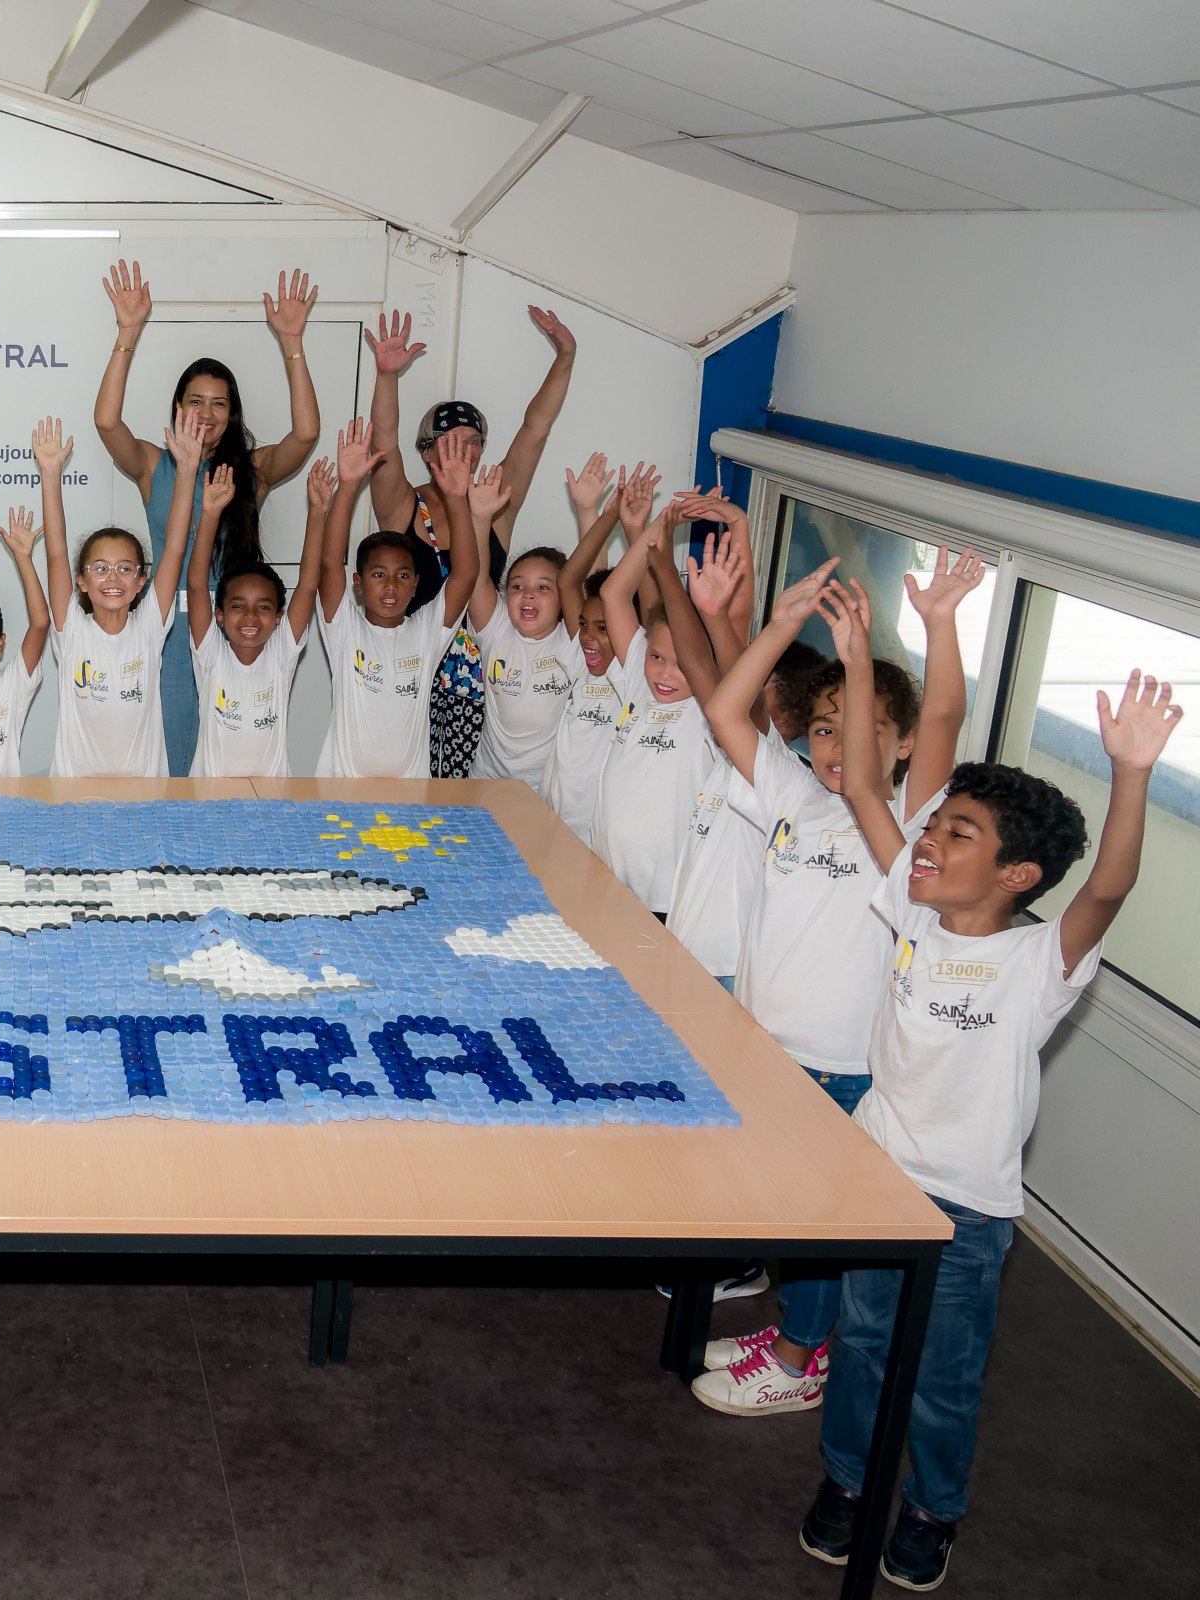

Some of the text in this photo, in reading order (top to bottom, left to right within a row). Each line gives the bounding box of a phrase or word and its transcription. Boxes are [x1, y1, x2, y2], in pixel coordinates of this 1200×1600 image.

[936, 963, 984, 978] 13000
[955, 1012, 997, 1029] PAUL
[756, 1381, 812, 1405] Sandy
